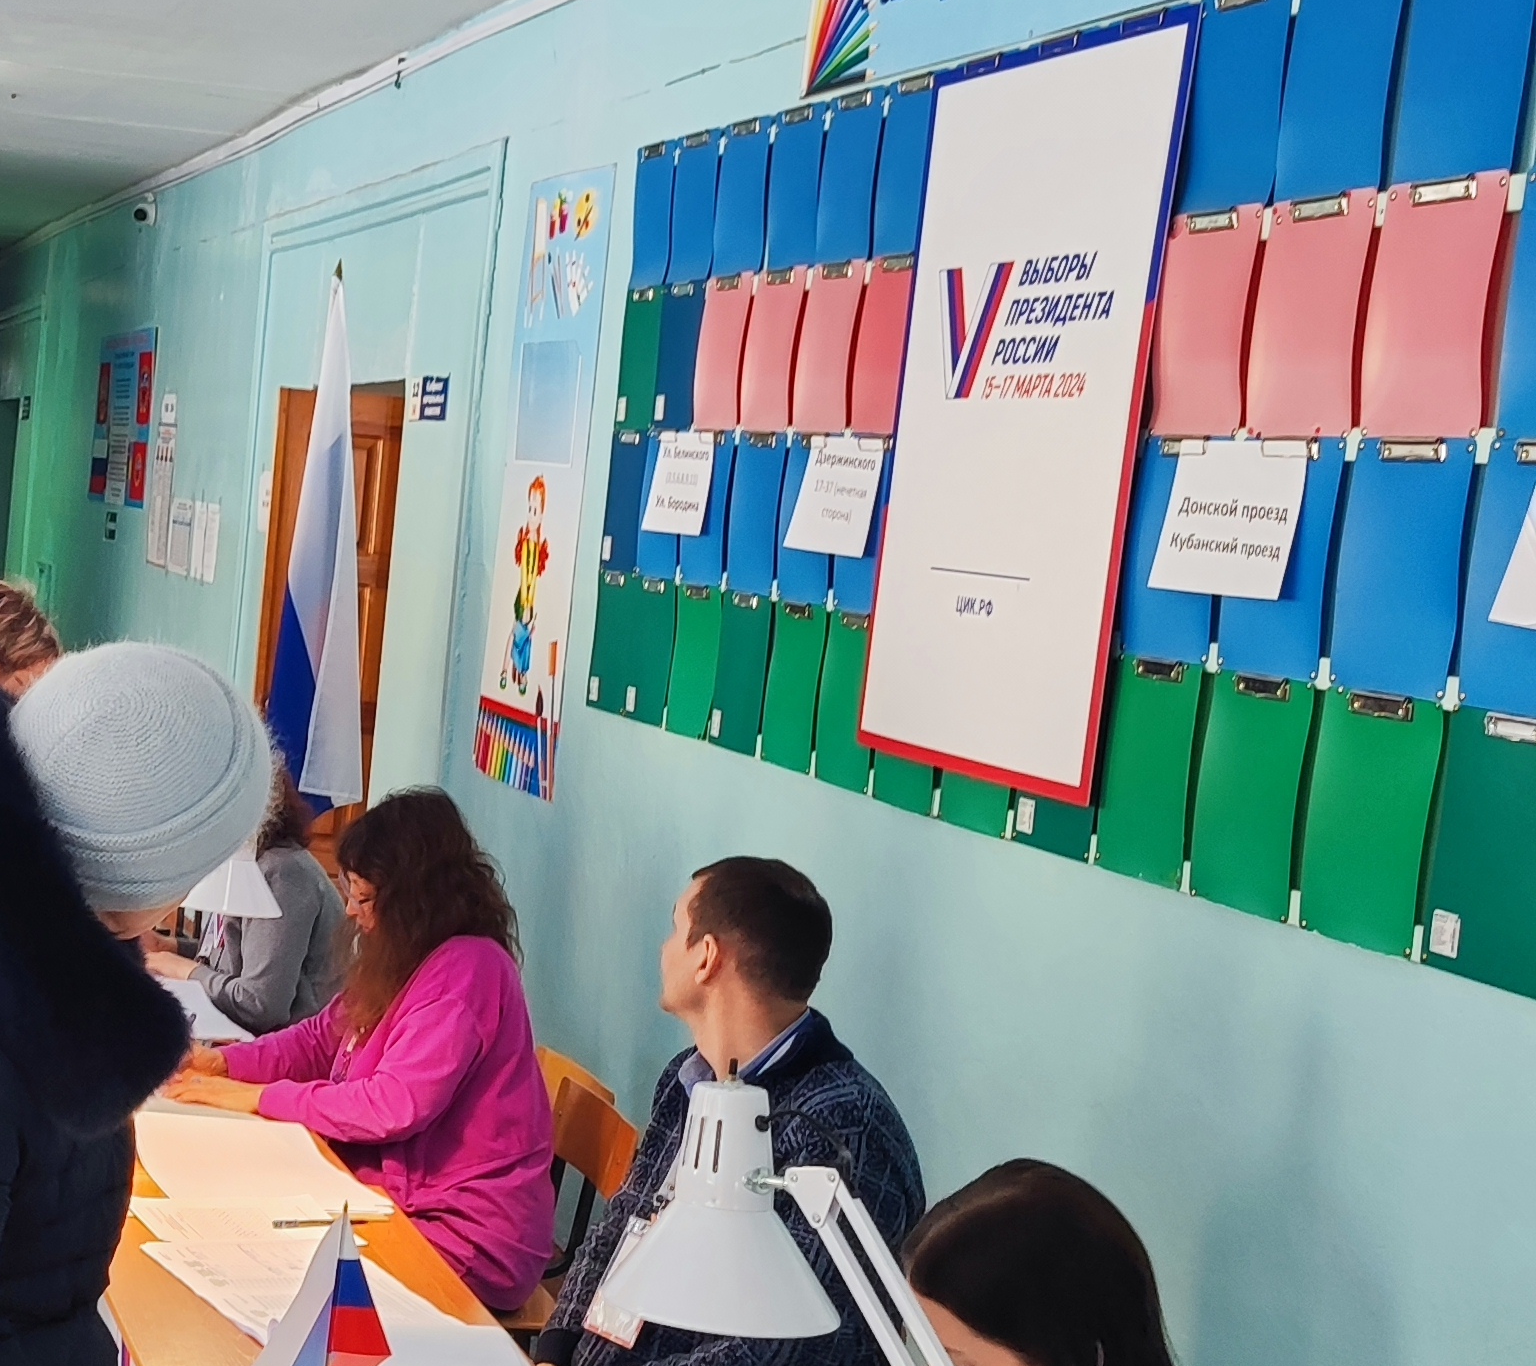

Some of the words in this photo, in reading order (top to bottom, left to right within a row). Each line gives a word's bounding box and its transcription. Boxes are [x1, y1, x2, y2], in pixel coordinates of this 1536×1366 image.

[1018, 250, 1098, 287] ВЫБОРЫ
[1004, 290, 1115, 328] ПРЕЗИДЕНТА
[991, 333, 1061, 366] РОССИИ
[1013, 373, 1055, 400] МАРТА
[1053, 372, 1087, 398] 2024
[815, 449, 876, 471] Дзержинского
[1177, 496, 1239, 518] Донской
[1241, 504, 1289, 525] проезд
[1169, 532, 1239, 555] Кубанский
[1240, 542, 1281, 562] проезд
[955, 595, 993, 617] ЦИК.РФ
